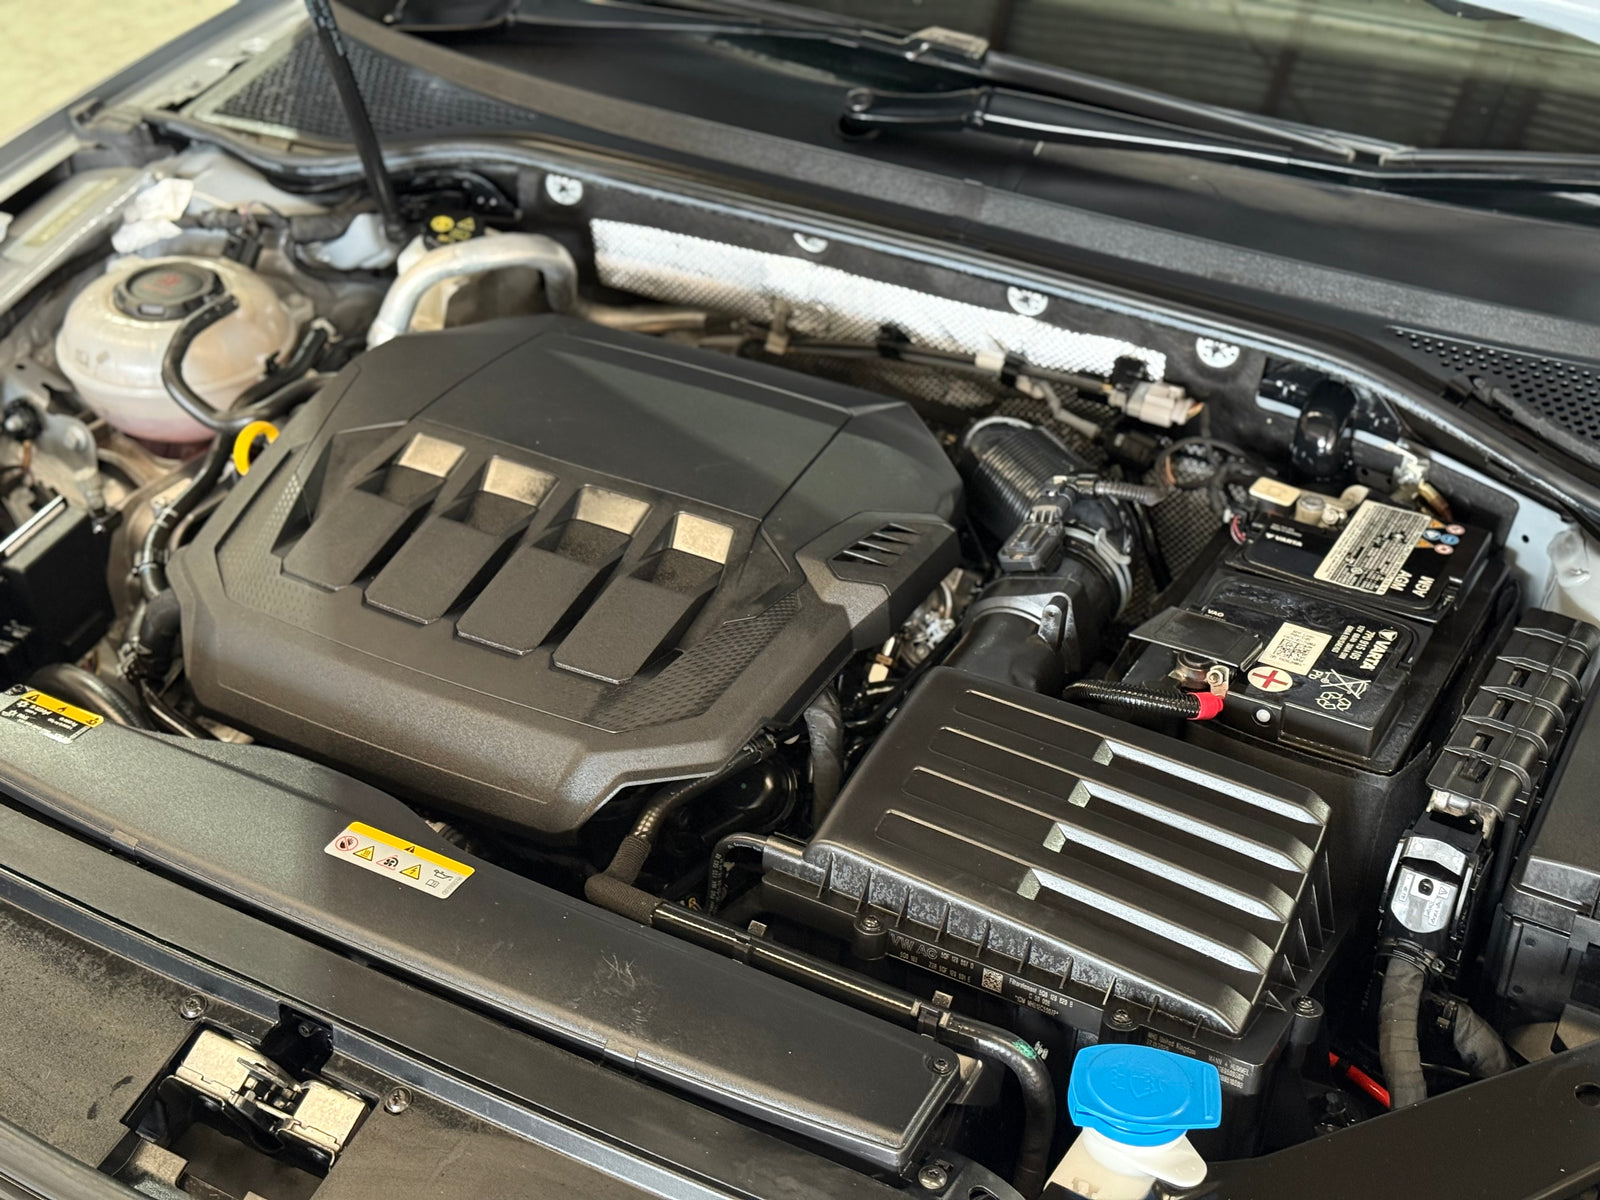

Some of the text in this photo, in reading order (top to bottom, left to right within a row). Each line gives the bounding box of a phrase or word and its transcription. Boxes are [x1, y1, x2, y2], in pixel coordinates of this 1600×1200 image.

[1390, 569, 1413, 592] AGM
[1411, 575, 1436, 598] AGM
[1355, 639, 1370, 651] 915
[1349, 649, 1363, 661] 105
[1360, 640, 1392, 671] VARTA
[1307, 669, 1324, 680] Pb
[890, 932, 938, 960] VW AG
[1175, 1042, 1197, 1056] Kingdom
